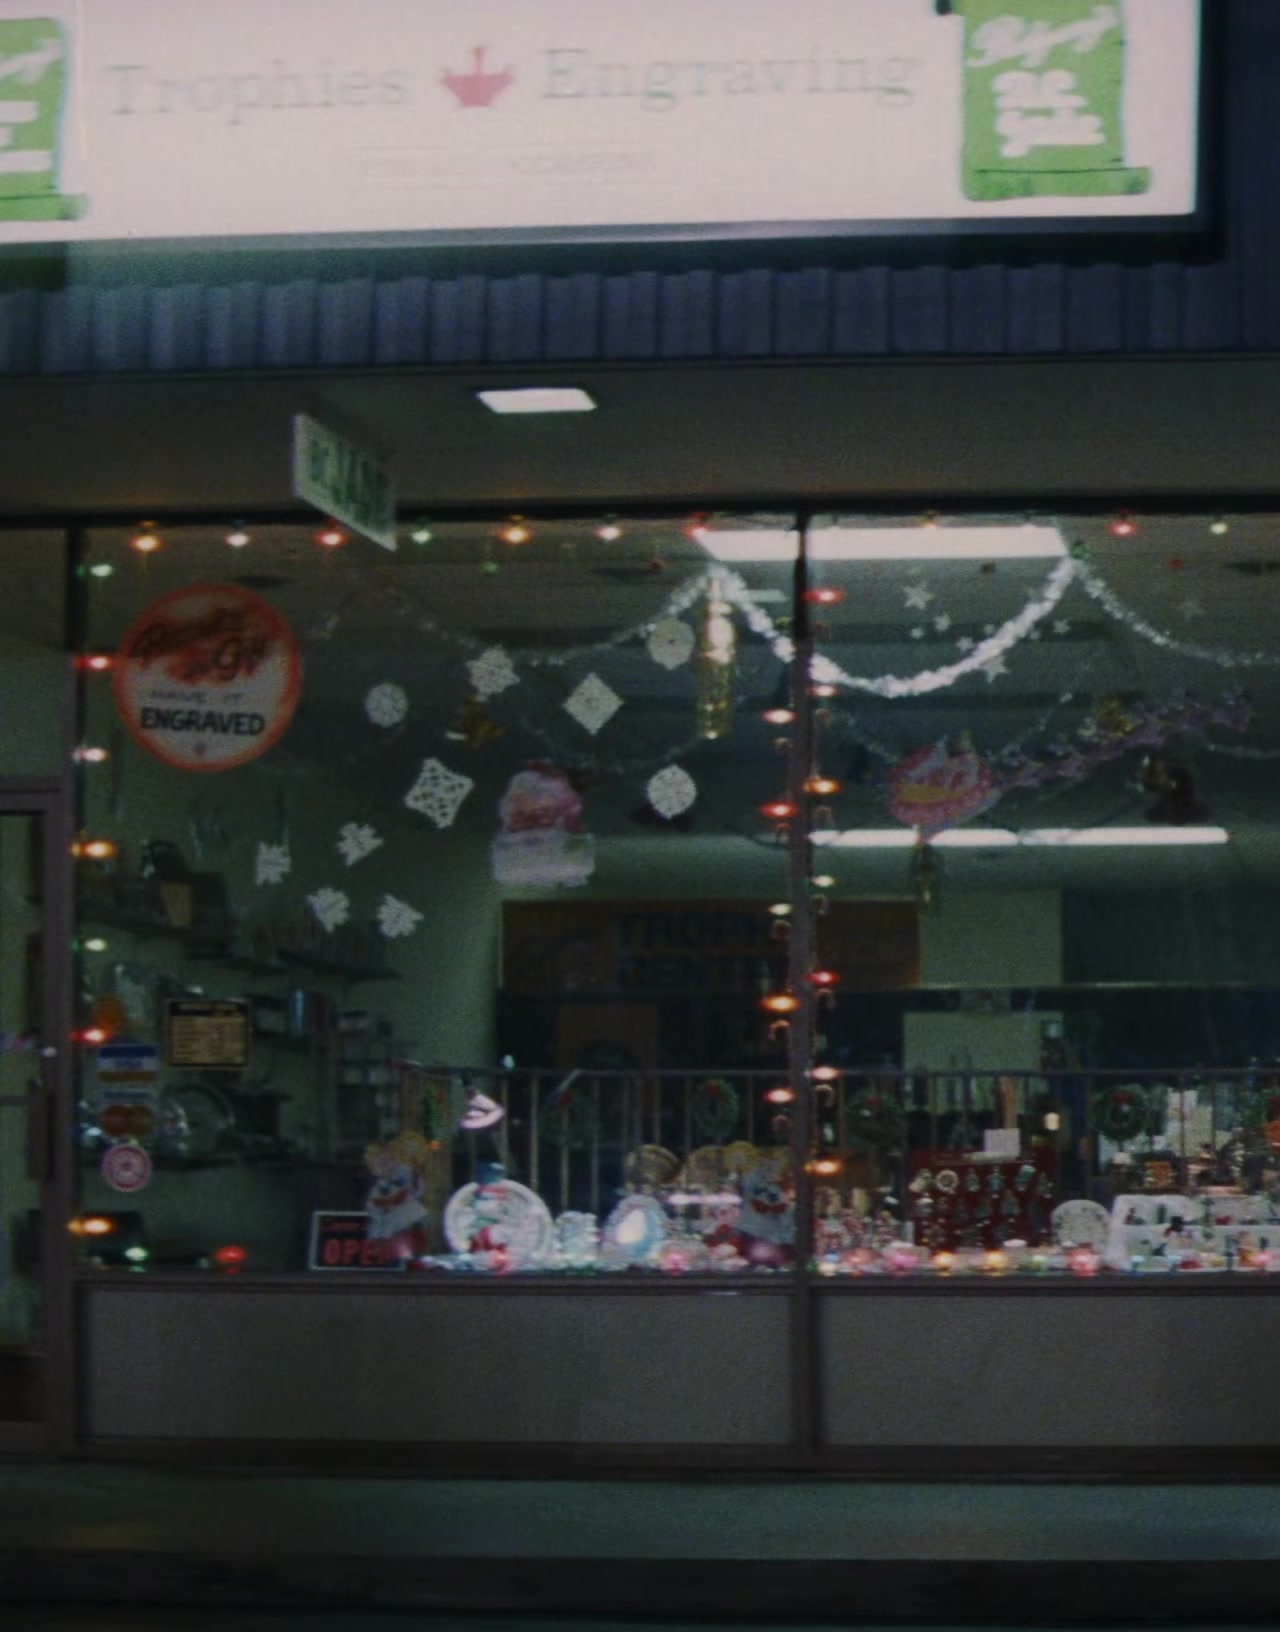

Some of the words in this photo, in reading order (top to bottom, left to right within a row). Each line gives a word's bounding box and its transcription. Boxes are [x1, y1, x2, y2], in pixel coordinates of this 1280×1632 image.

[103, 60, 410, 125] Trophies
[540, 46, 923, 110] Engraving
[141, 707, 265, 736] ENGRAVED
[612, 910, 788, 948] TROPH
